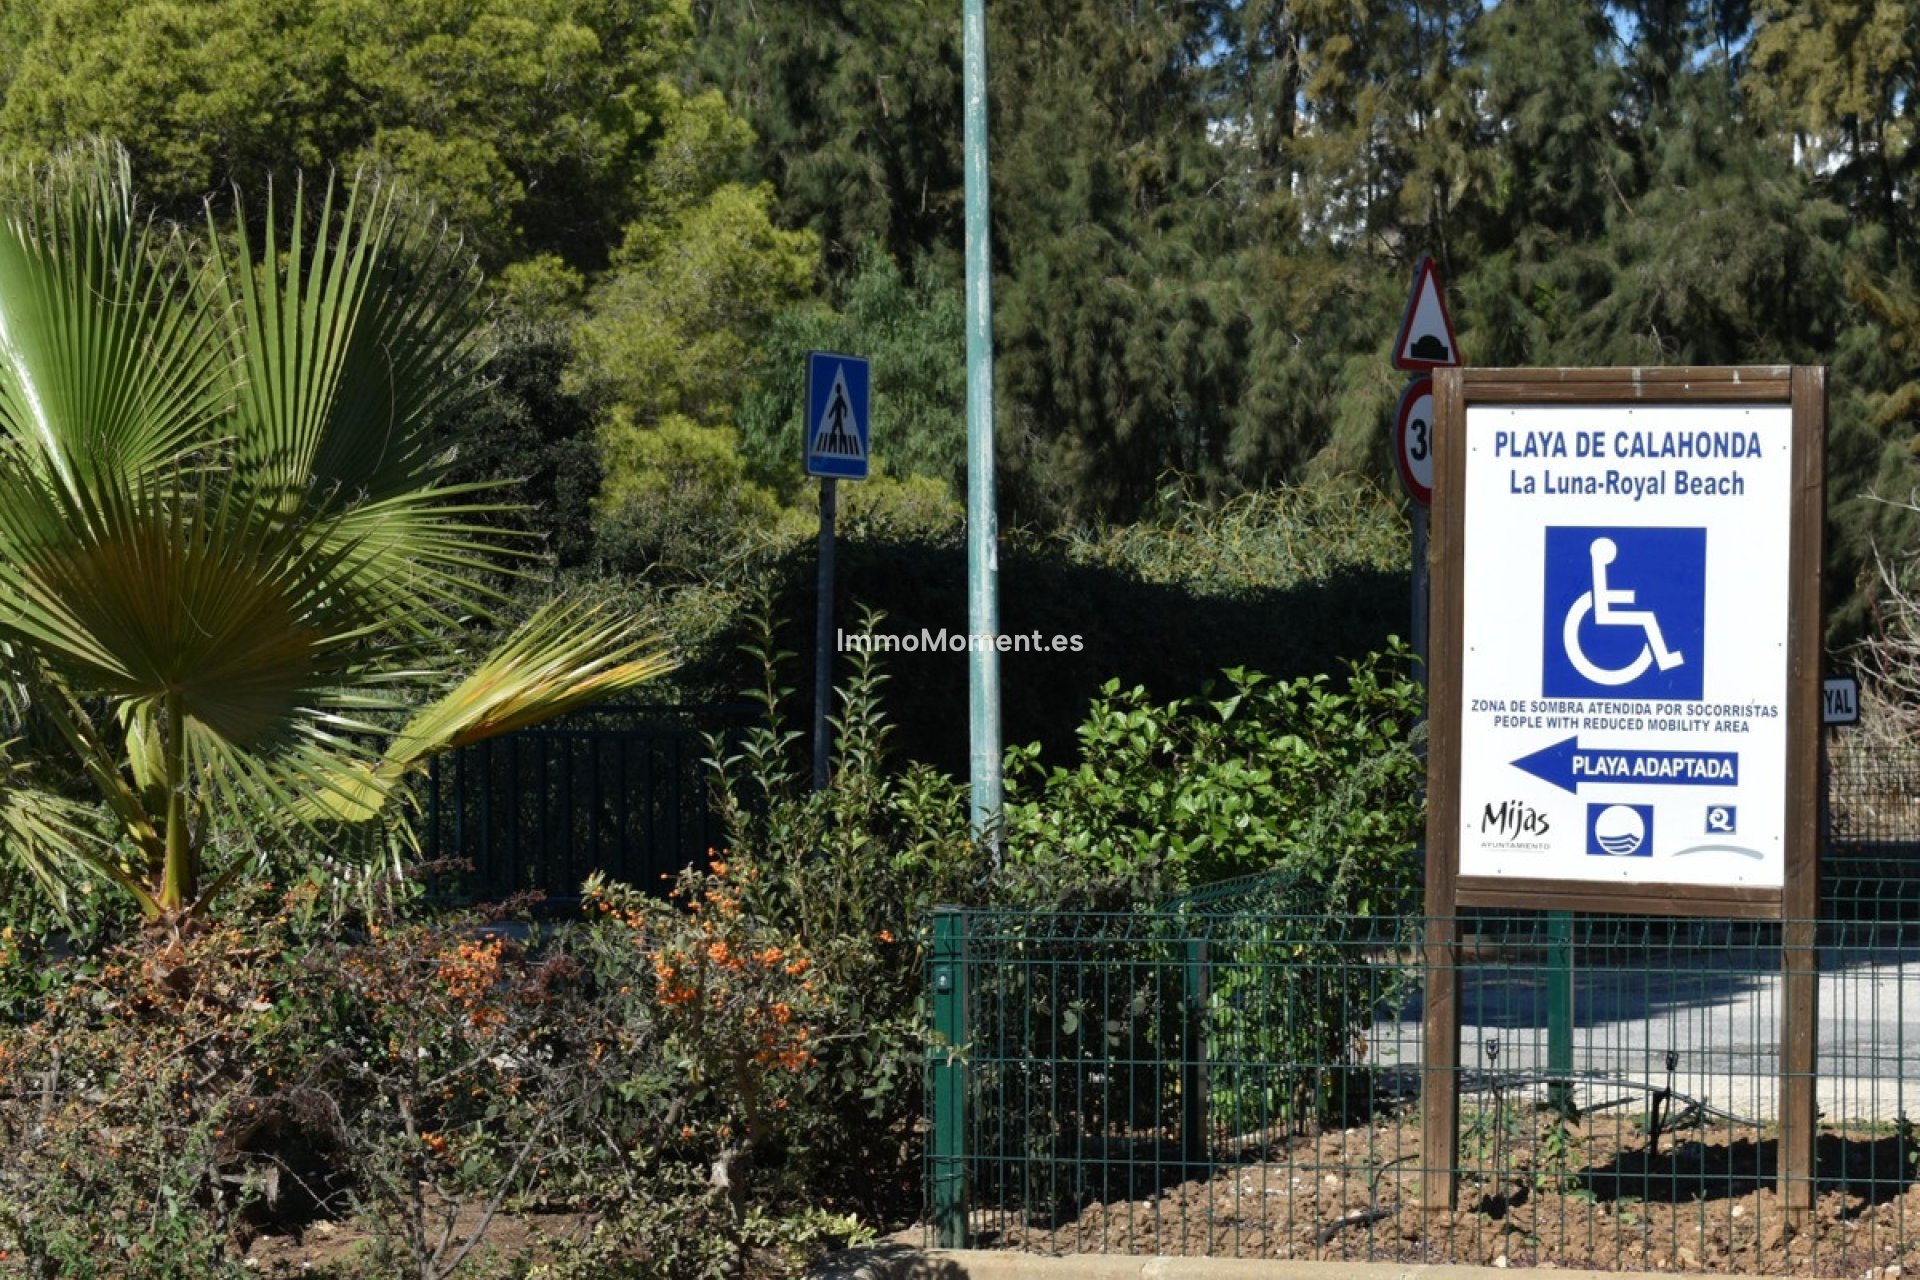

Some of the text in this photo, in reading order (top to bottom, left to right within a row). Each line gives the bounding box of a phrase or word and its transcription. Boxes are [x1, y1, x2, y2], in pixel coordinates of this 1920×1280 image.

[1410, 418, 1433, 461] 3
[1495, 431, 1762, 459] PLAYA DE CALAHONDA
[1510, 470, 1745, 502] La Luna-Royal Beach
[1471, 699, 1778, 718] ZONA DE SOMBRA ATENDIDA POR SOCORRISTAS
[1494, 715, 1750, 733] PEOPLE WITH REDUCED MOBILITY AREA
[1572, 755, 1734, 778] PLAYA ADAPTADA
[1481, 799, 1550, 841] Mijas
[1480, 842, 1550, 850] AYUNTAMIENTO
